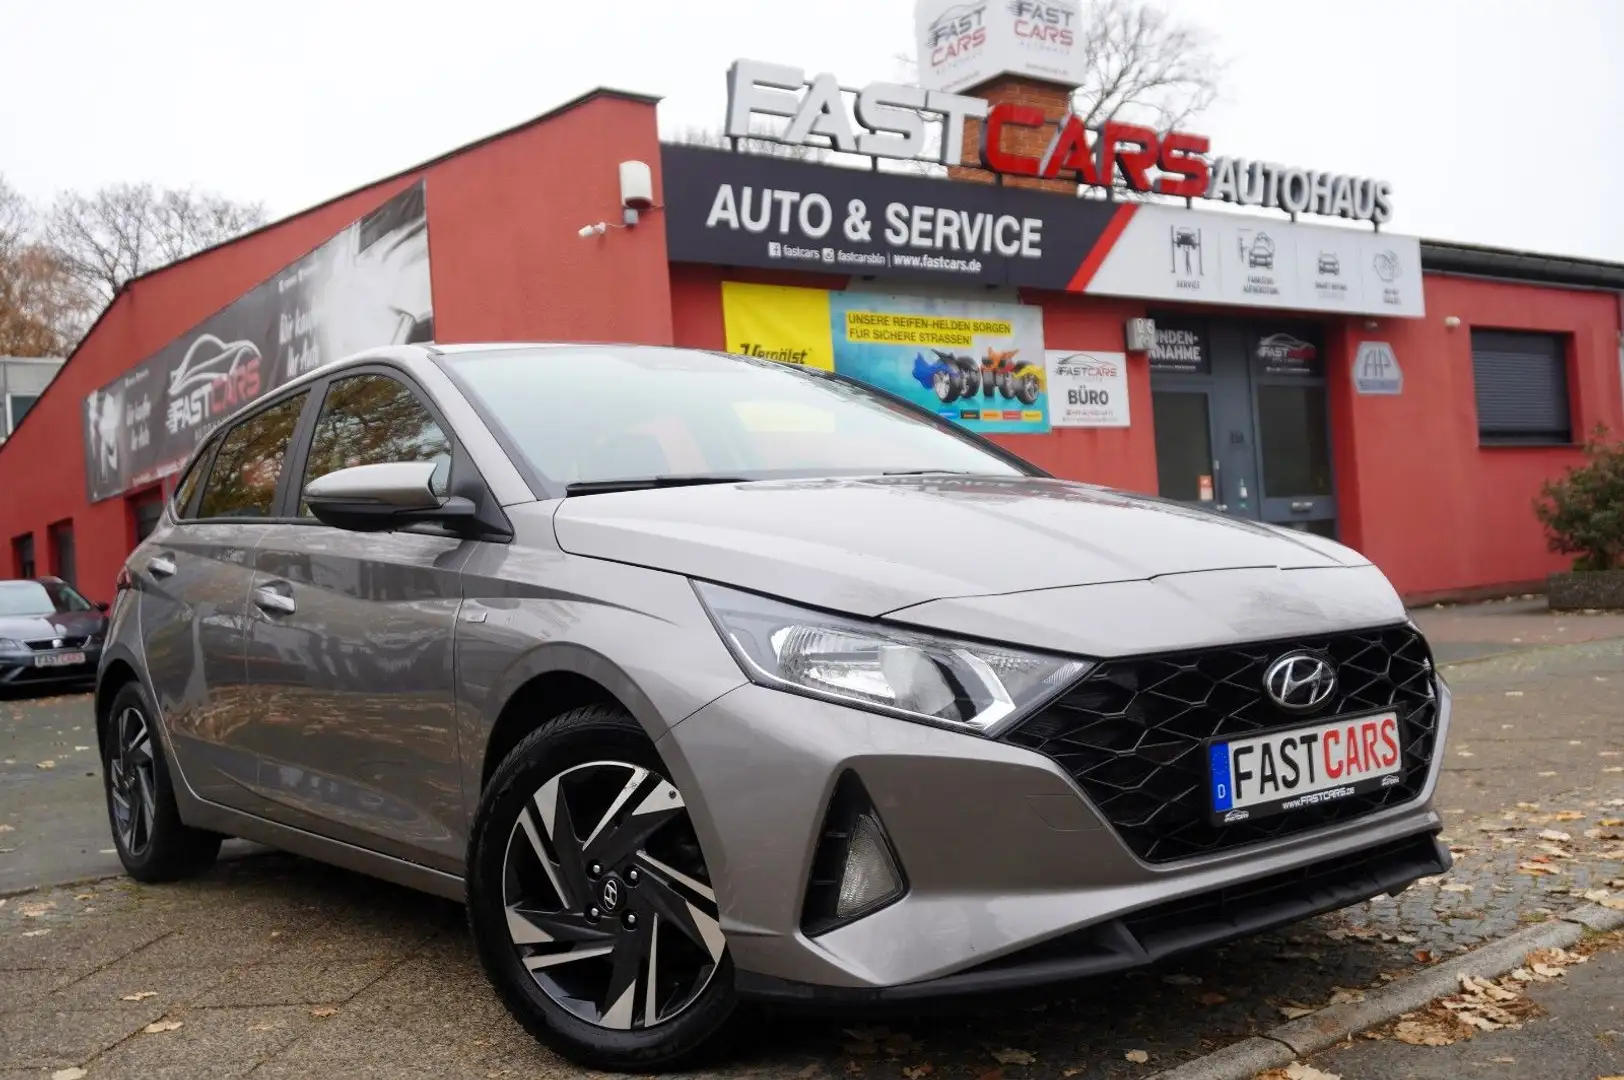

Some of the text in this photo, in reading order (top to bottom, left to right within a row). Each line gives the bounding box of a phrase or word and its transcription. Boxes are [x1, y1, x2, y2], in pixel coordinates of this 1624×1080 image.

[931, 5, 986, 47] FAST
[1014, 0, 1074, 27] FAST
[931, 27, 986, 67] CARS
[1013, 20, 1074, 47] CARS
[1209, 156, 1394, 223] AUTOHAUS
[706, 183, 1043, 258] AUTO & SERVICE
[783, 245, 820, 259] fastcars
[894, 253, 981, 272] www.fastcars.de
[848, 313, 1011, 333] UNSERE REIFEN-HELDEN SORGEN
[874, 330, 916, 341] SICHERE
[919, 333, 971, 345] STRASSEN!
[1056, 367, 1117, 377] FASTCARS
[168, 356, 261, 433] FASTCARS
[1068, 384, 1110, 405] BÜRO
[1233, 719, 1398, 800] FASTCARS
[1217, 782, 1227, 800] D
